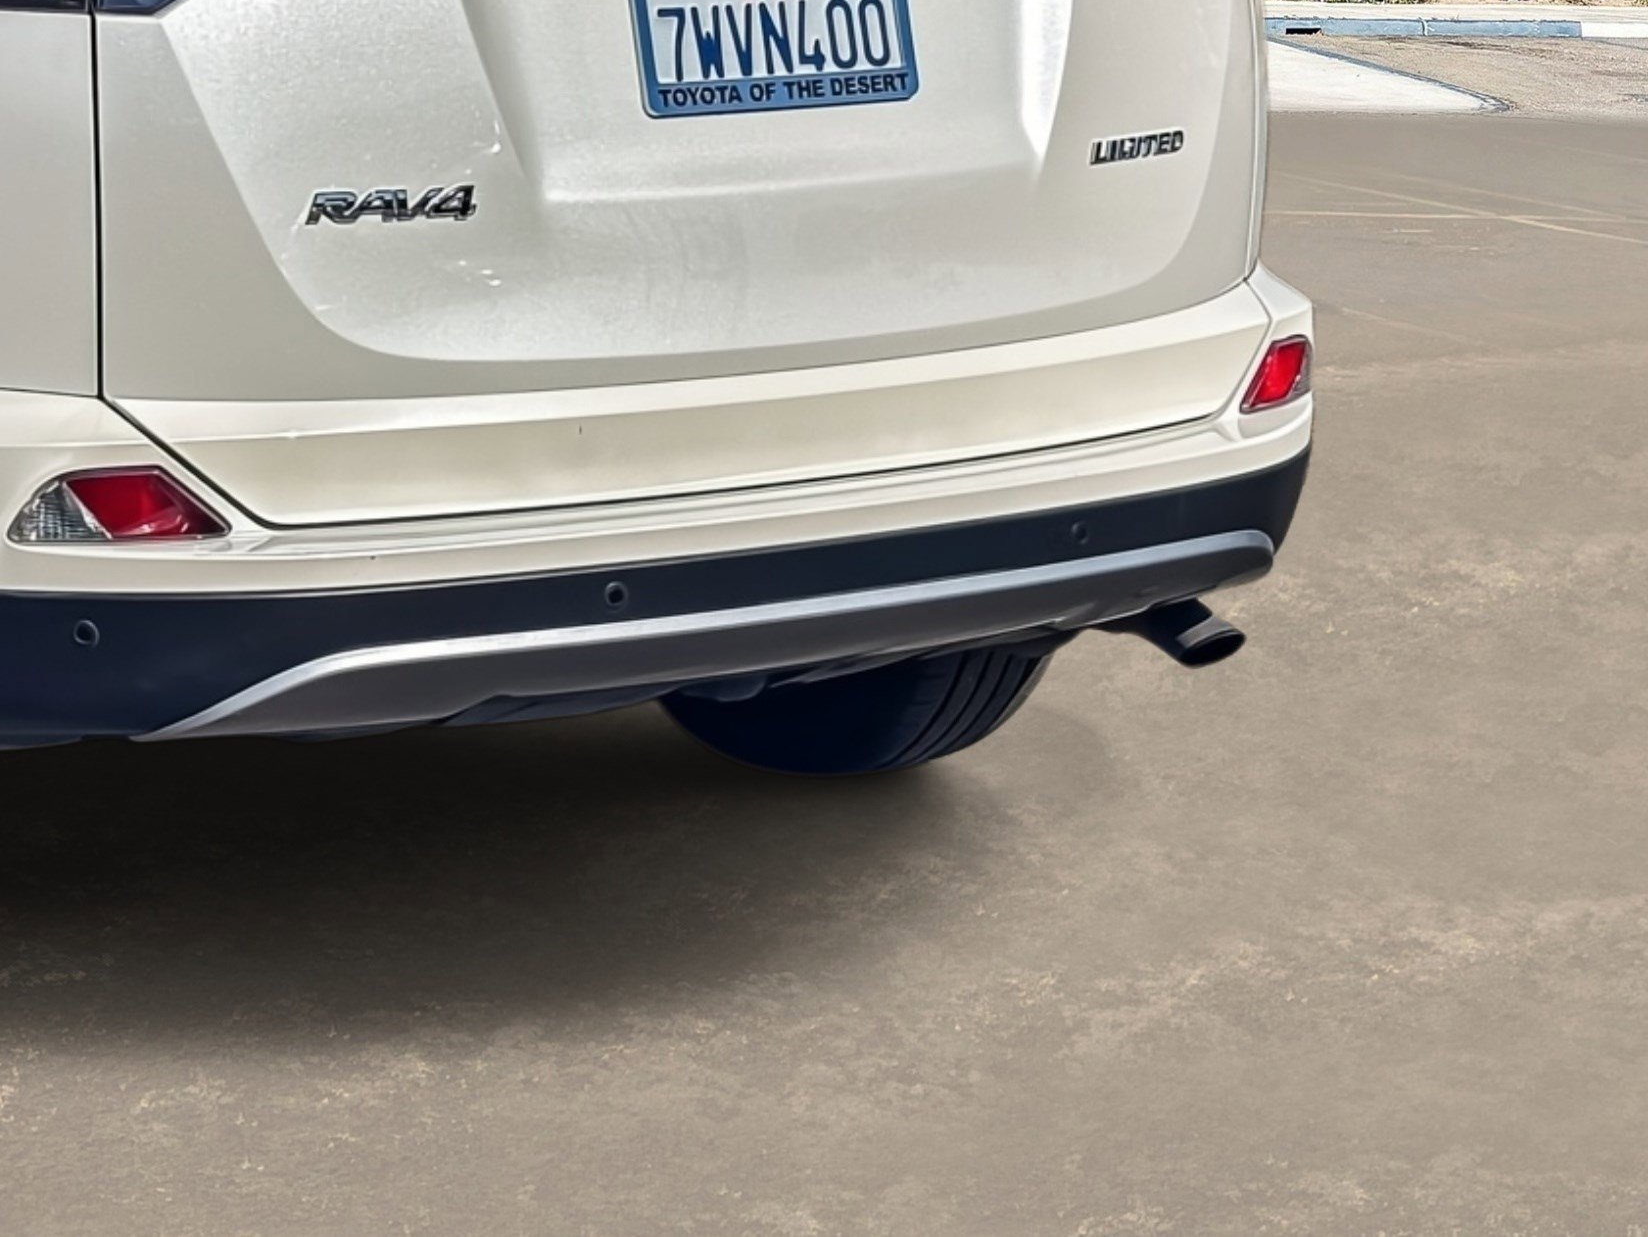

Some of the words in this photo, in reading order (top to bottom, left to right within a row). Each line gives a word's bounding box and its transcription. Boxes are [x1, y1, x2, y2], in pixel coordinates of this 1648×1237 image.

[658, 85, 743, 107] TOYOTA
[749, 82, 777, 100] OF
[782, 79, 826, 99] THE
[830, 72, 909, 95] DESERT
[1089, 129, 1184, 166] LIMITED
[304, 184, 477, 225] RAV4
